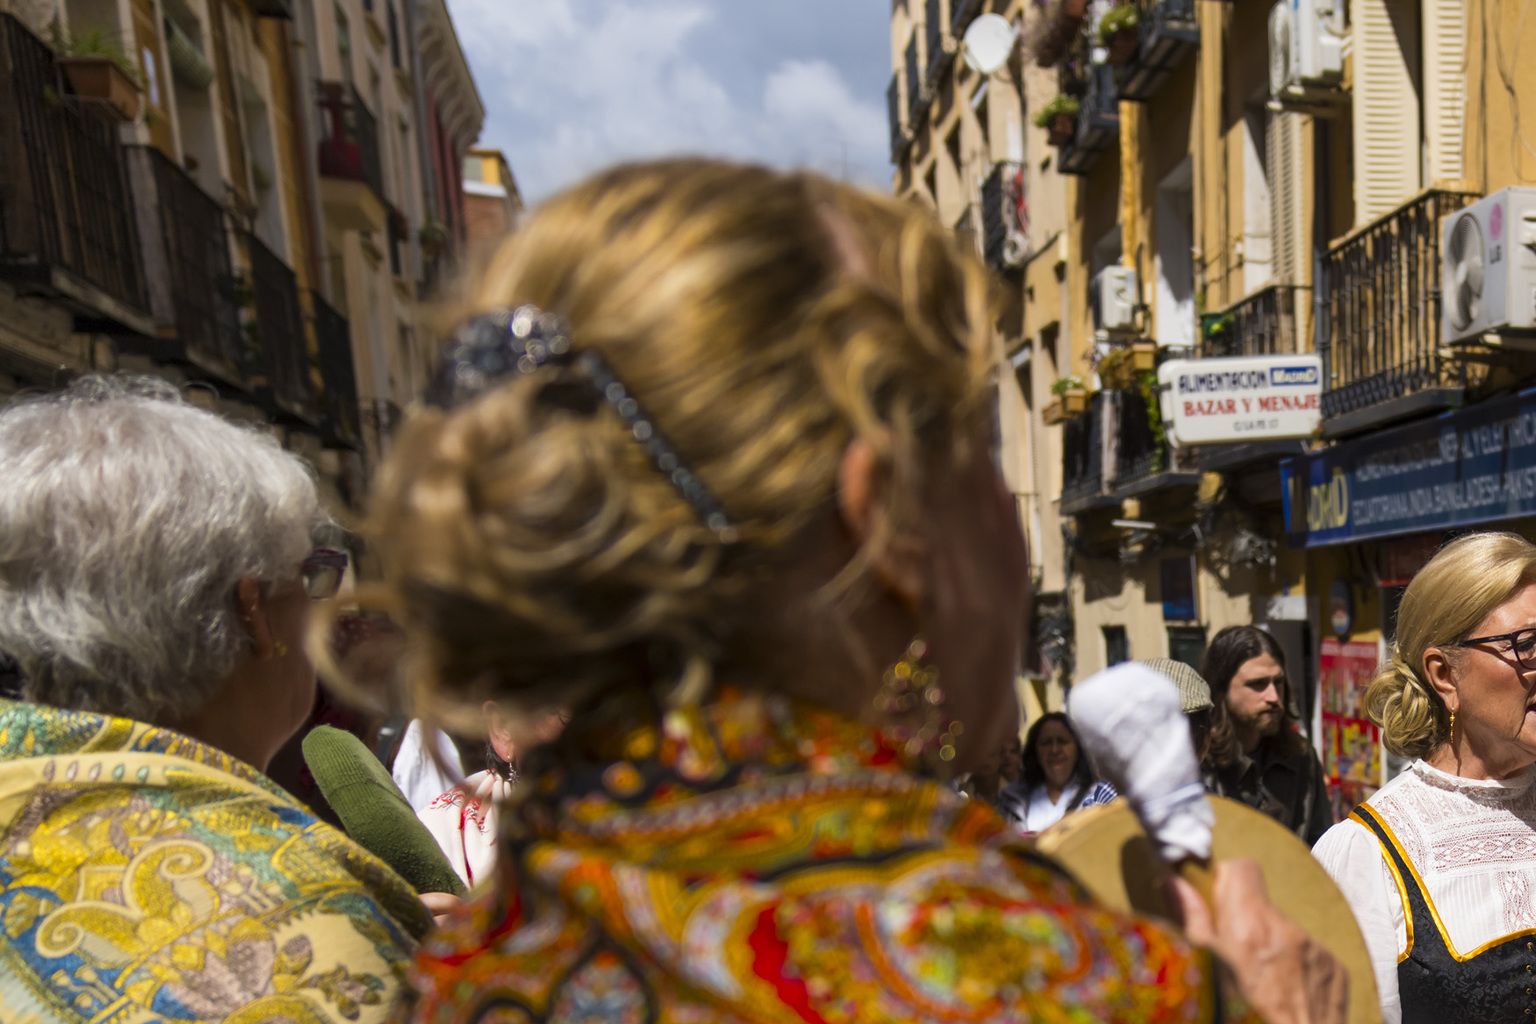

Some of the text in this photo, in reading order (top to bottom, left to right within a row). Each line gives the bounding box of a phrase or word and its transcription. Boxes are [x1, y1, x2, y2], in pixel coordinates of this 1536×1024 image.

[1178, 371, 1267, 394] ALIMENTACION
[1183, 394, 1321, 416] BAZAR Y MENAJE
